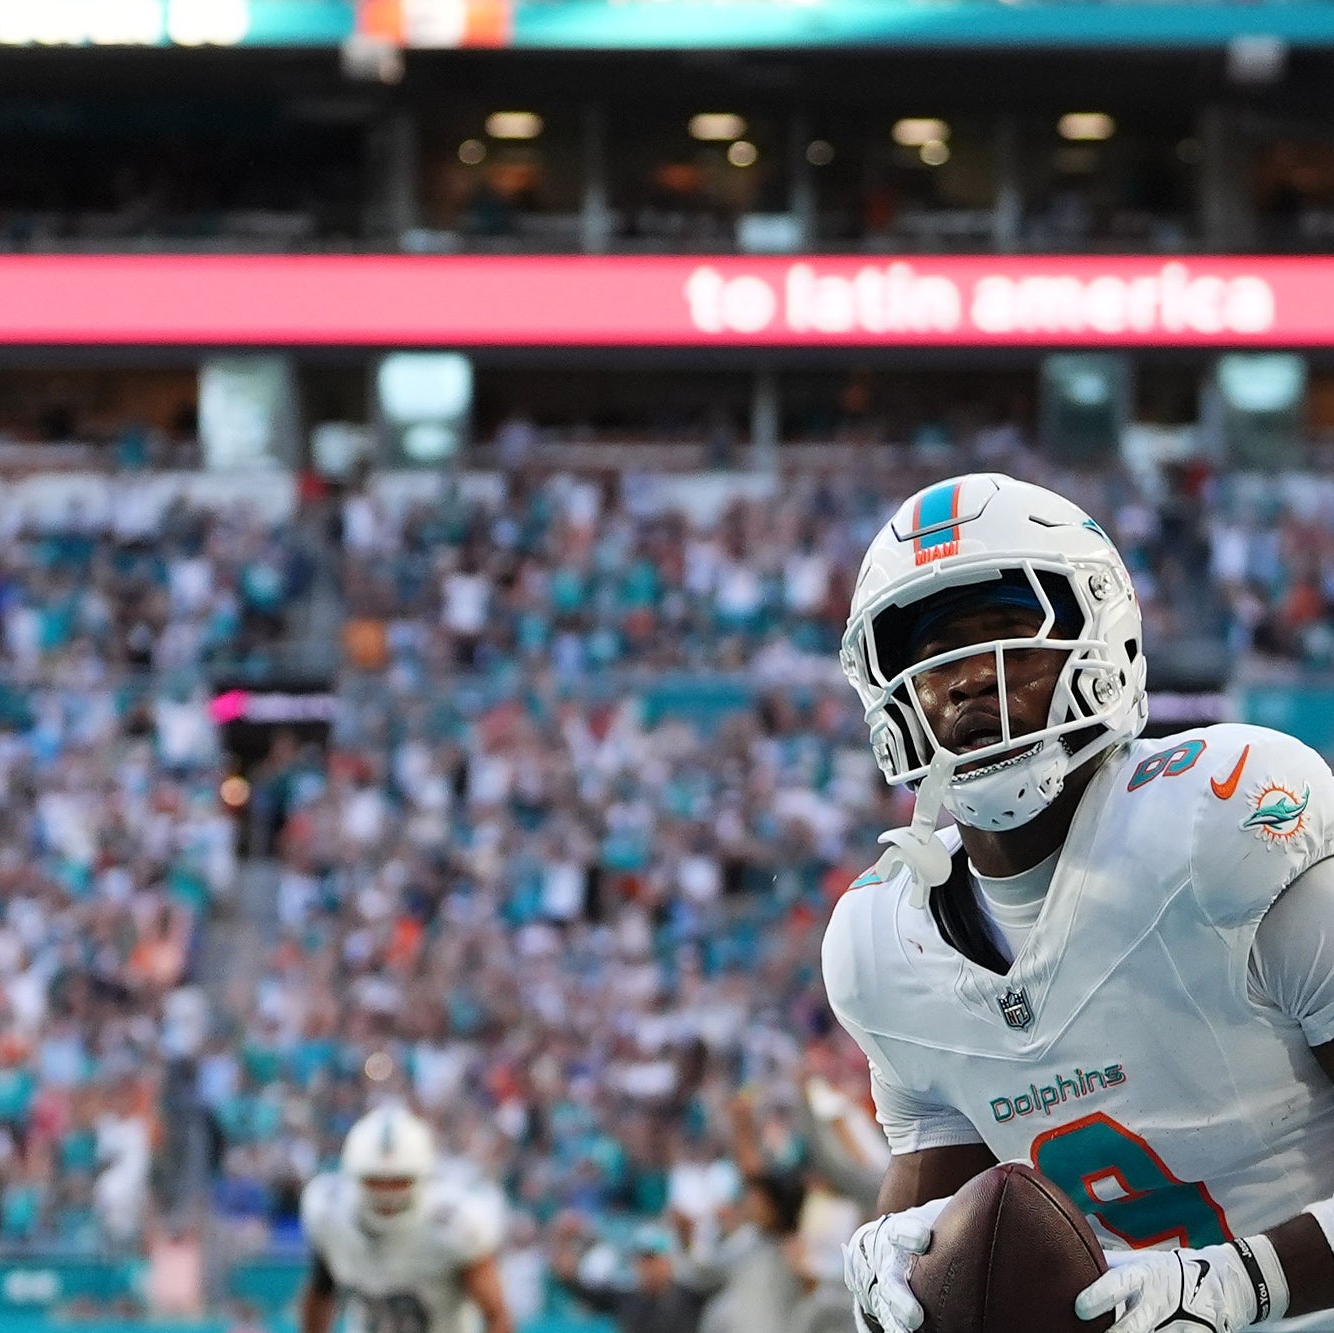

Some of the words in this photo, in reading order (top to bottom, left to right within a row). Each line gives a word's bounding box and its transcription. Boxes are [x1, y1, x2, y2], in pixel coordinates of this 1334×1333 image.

[686, 267, 775, 333] to
[786, 262, 961, 333] latin
[971, 262, 1275, 333] america
[915, 540, 959, 567] MIAMI
[990, 1064, 1127, 1123] Dolphins
[1030, 1111, 1233, 1250] 9
[1258, 1283, 1268, 1304] You
